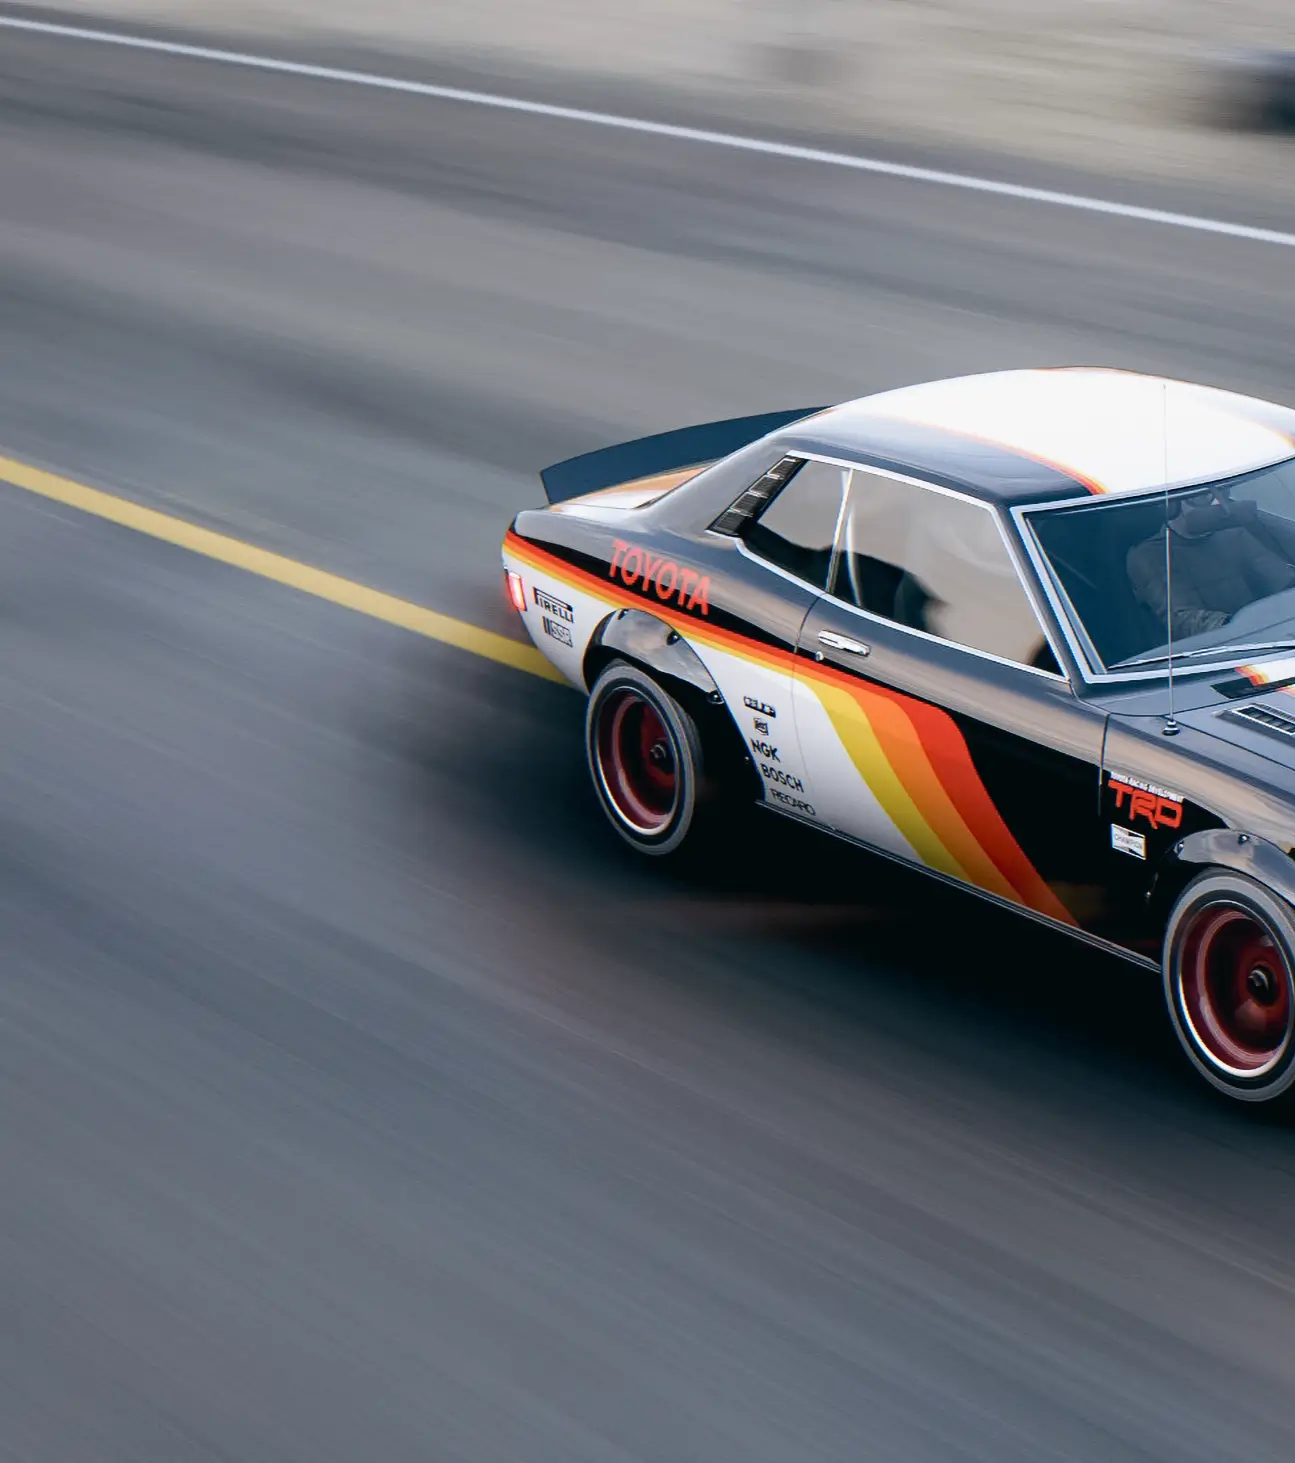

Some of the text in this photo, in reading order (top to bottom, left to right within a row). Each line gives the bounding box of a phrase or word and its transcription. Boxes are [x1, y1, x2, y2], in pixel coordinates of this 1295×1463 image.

[608, 538, 711, 616] TOYOTA
[532, 586, 574, 624] PIRELLI
[750, 738, 781, 763] NGK
[760, 763, 804, 793] BOSCH
[770, 788, 816, 816] RECARO
[1108, 779, 1183, 830] TRD
